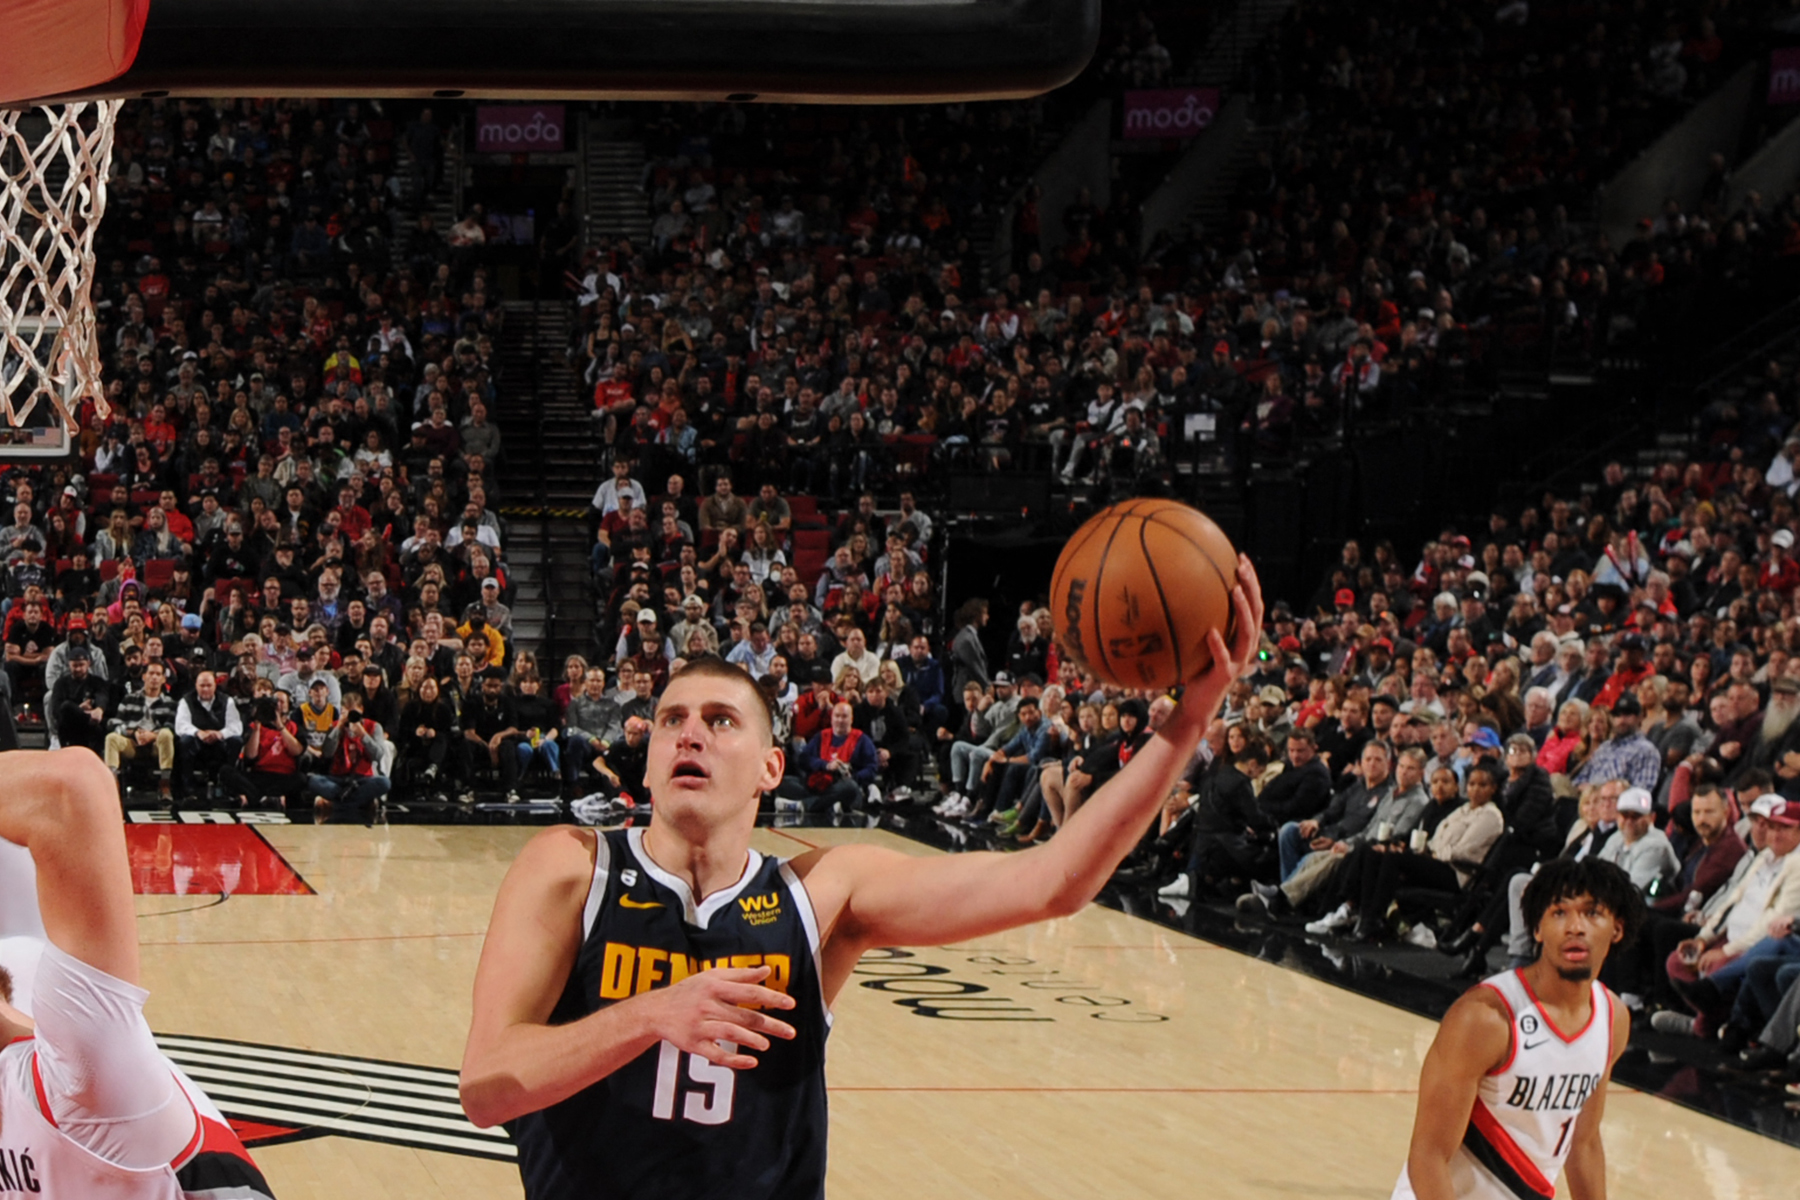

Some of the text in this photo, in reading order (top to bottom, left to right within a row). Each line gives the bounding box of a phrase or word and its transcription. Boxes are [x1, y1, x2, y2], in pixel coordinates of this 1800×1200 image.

[480, 111, 560, 142] moda
[620, 868, 638, 887] 6
[738, 893, 779, 913] WU
[742, 907, 781, 922] Western
[750, 916, 777, 926] Union
[652, 1039, 738, 1126] 15
